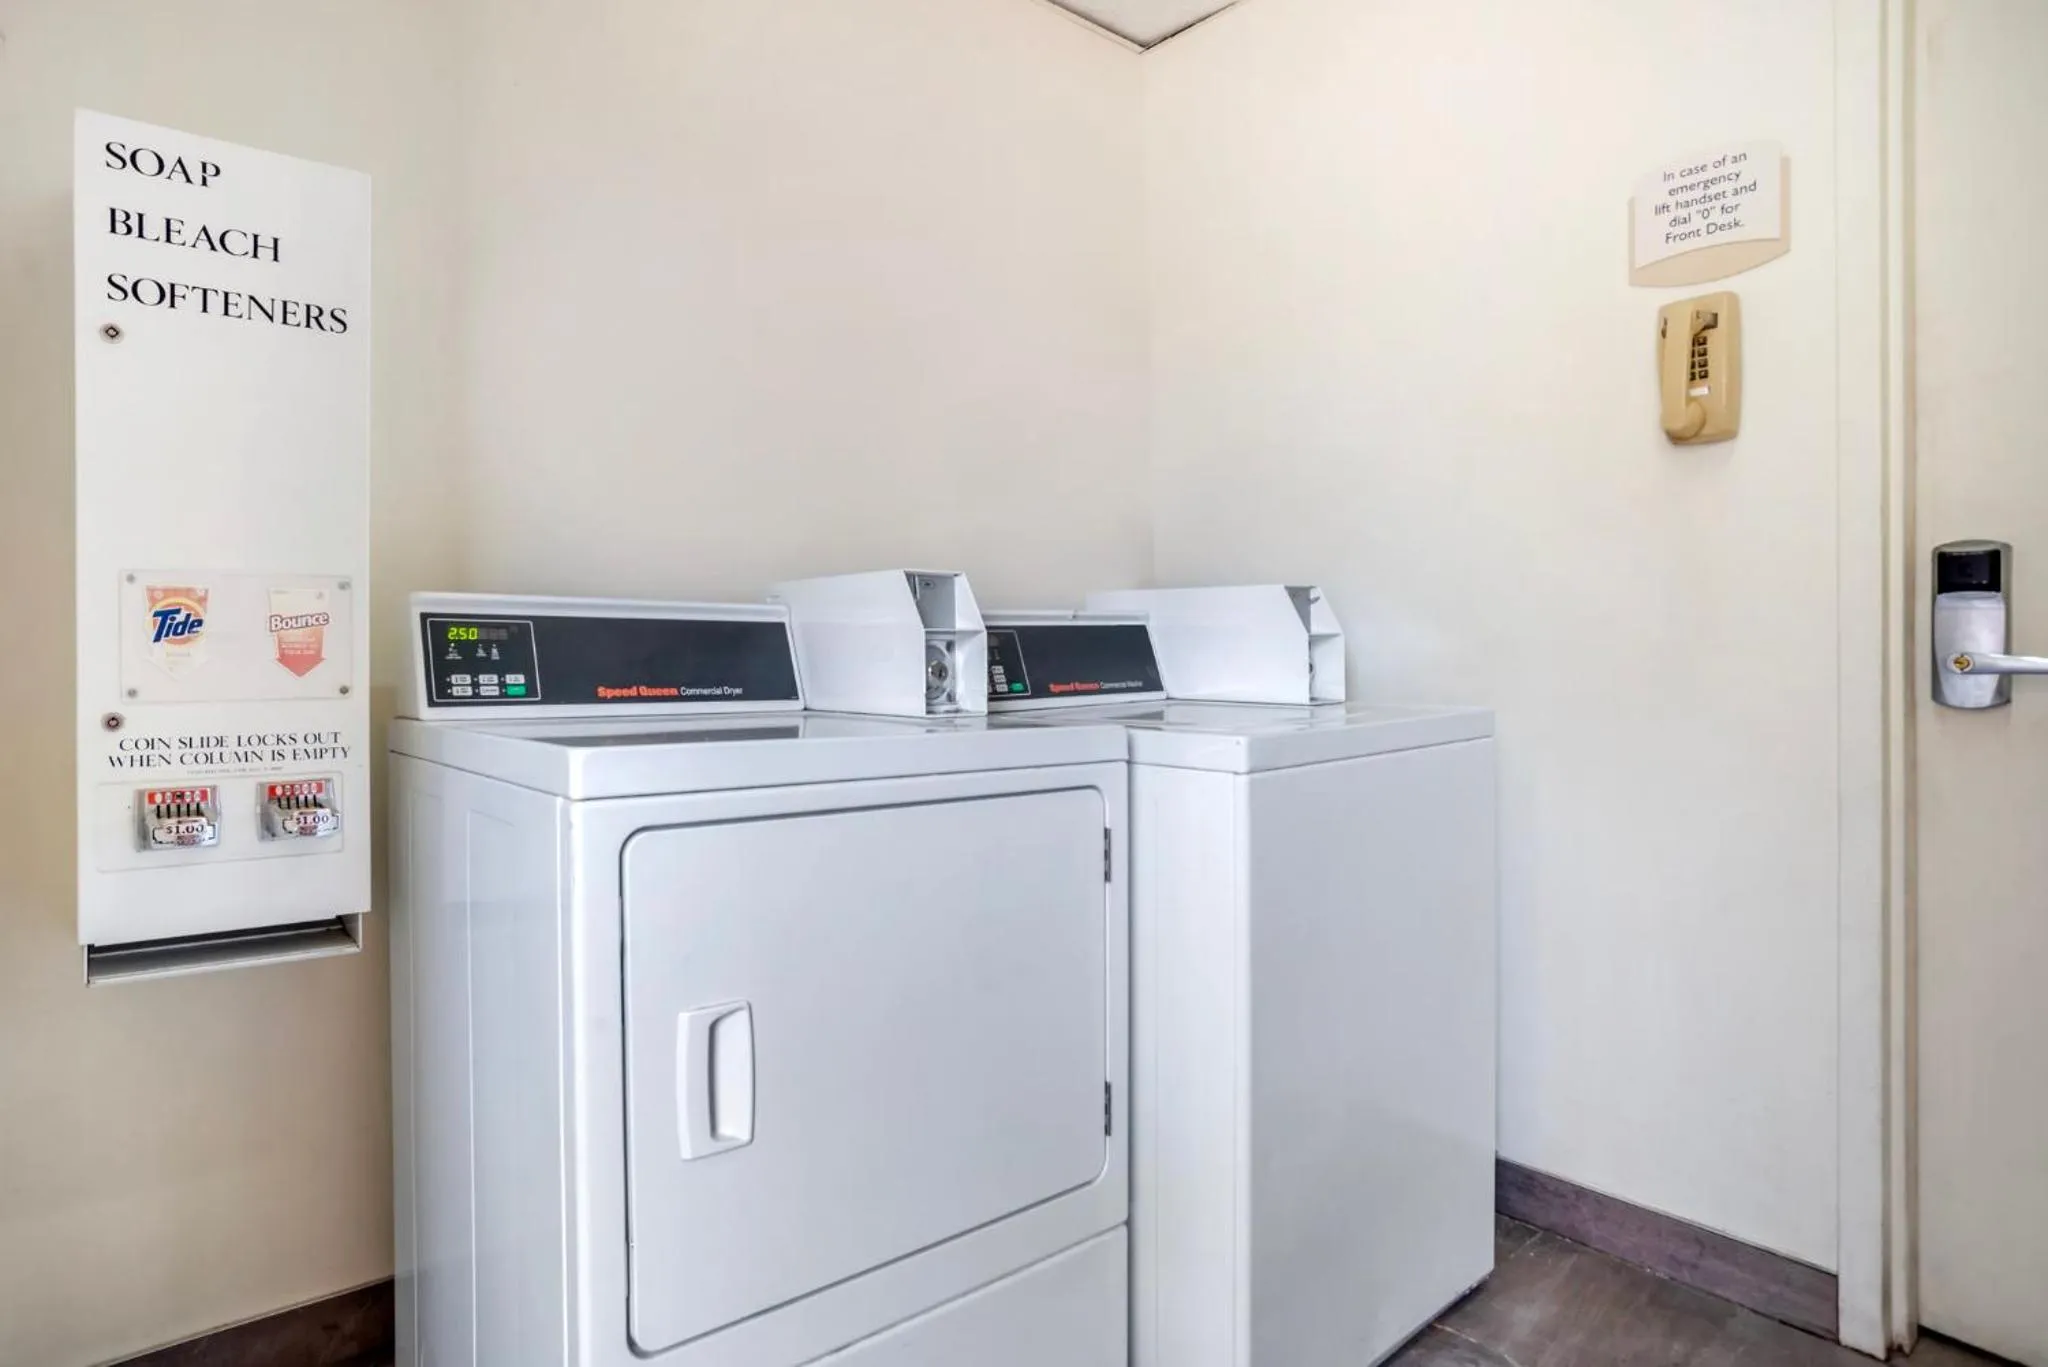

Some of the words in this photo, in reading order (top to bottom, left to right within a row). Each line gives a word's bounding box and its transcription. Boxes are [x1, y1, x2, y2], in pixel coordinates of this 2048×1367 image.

[105, 141, 221, 187] SOAP
[1663, 171, 1675, 182] In
[1680, 164, 1708, 178] case
[1712, 155, 1728, 169] of
[1731, 152, 1747, 165] an
[1668, 170, 1742, 196] emergency
[1654, 203, 1671, 216] lift
[1675, 190, 1728, 210] handset
[1731, 180, 1757, 197] and
[1668, 213, 1692, 228] dial
[1721, 203, 1740, 214] for
[109, 207, 280, 262] BLEACH
[1665, 227, 1702, 244] Front
[1706, 218, 1744, 235] Desk.
[106, 272, 348, 334] SOFTENERS
[152, 607, 204, 643] Tide
[269, 612, 330, 632] Bounce
[597, 685, 637, 698] Speed
[119, 737, 172, 752] COIN
[178, 735, 229, 750] SLIDE
[236, 732, 298, 748] LOCKS
[303, 731, 342, 745] OUT
[108, 754, 172, 769] WHEN
[179, 750, 264, 766] COLUMN
[271, 748, 286, 762] IS
[292, 746, 352, 761] EMPTY
